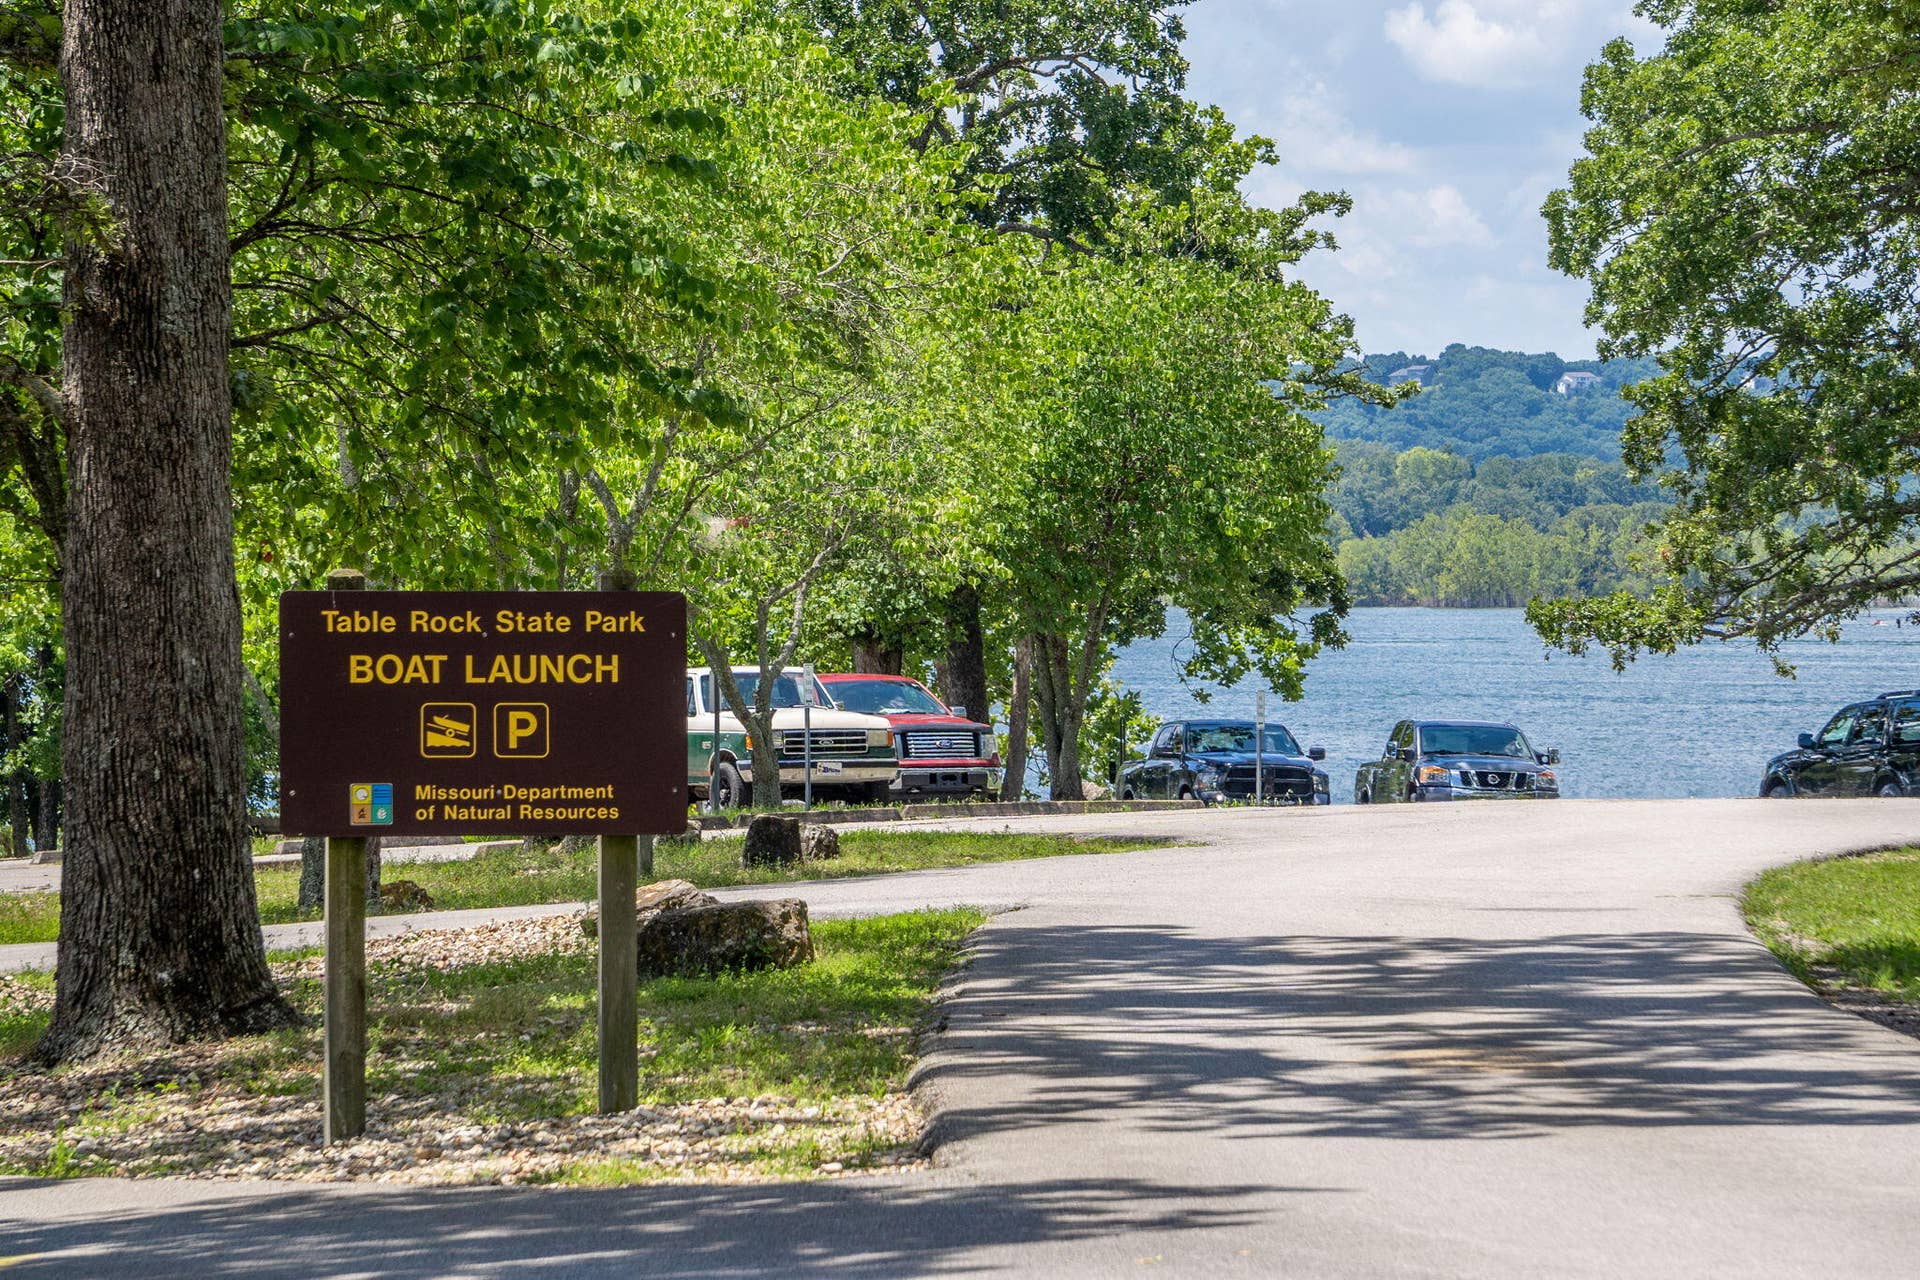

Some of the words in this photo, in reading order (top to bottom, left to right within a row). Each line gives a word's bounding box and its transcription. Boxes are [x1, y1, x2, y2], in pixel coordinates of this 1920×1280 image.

[321, 610, 396, 633] Table
[410, 610, 481, 633] Rock
[495, 610, 571, 633] State
[585, 610, 645, 633] Park
[349, 654, 448, 684] BOAT
[464, 654, 620, 684] LAUNCH
[508, 710, 539, 749] P
[415, 784, 495, 800] Missouri
[503, 784, 614, 802] Department
[415, 804, 435, 820] of
[443, 804, 512, 820] Natural
[518, 804, 620, 820] Resources
